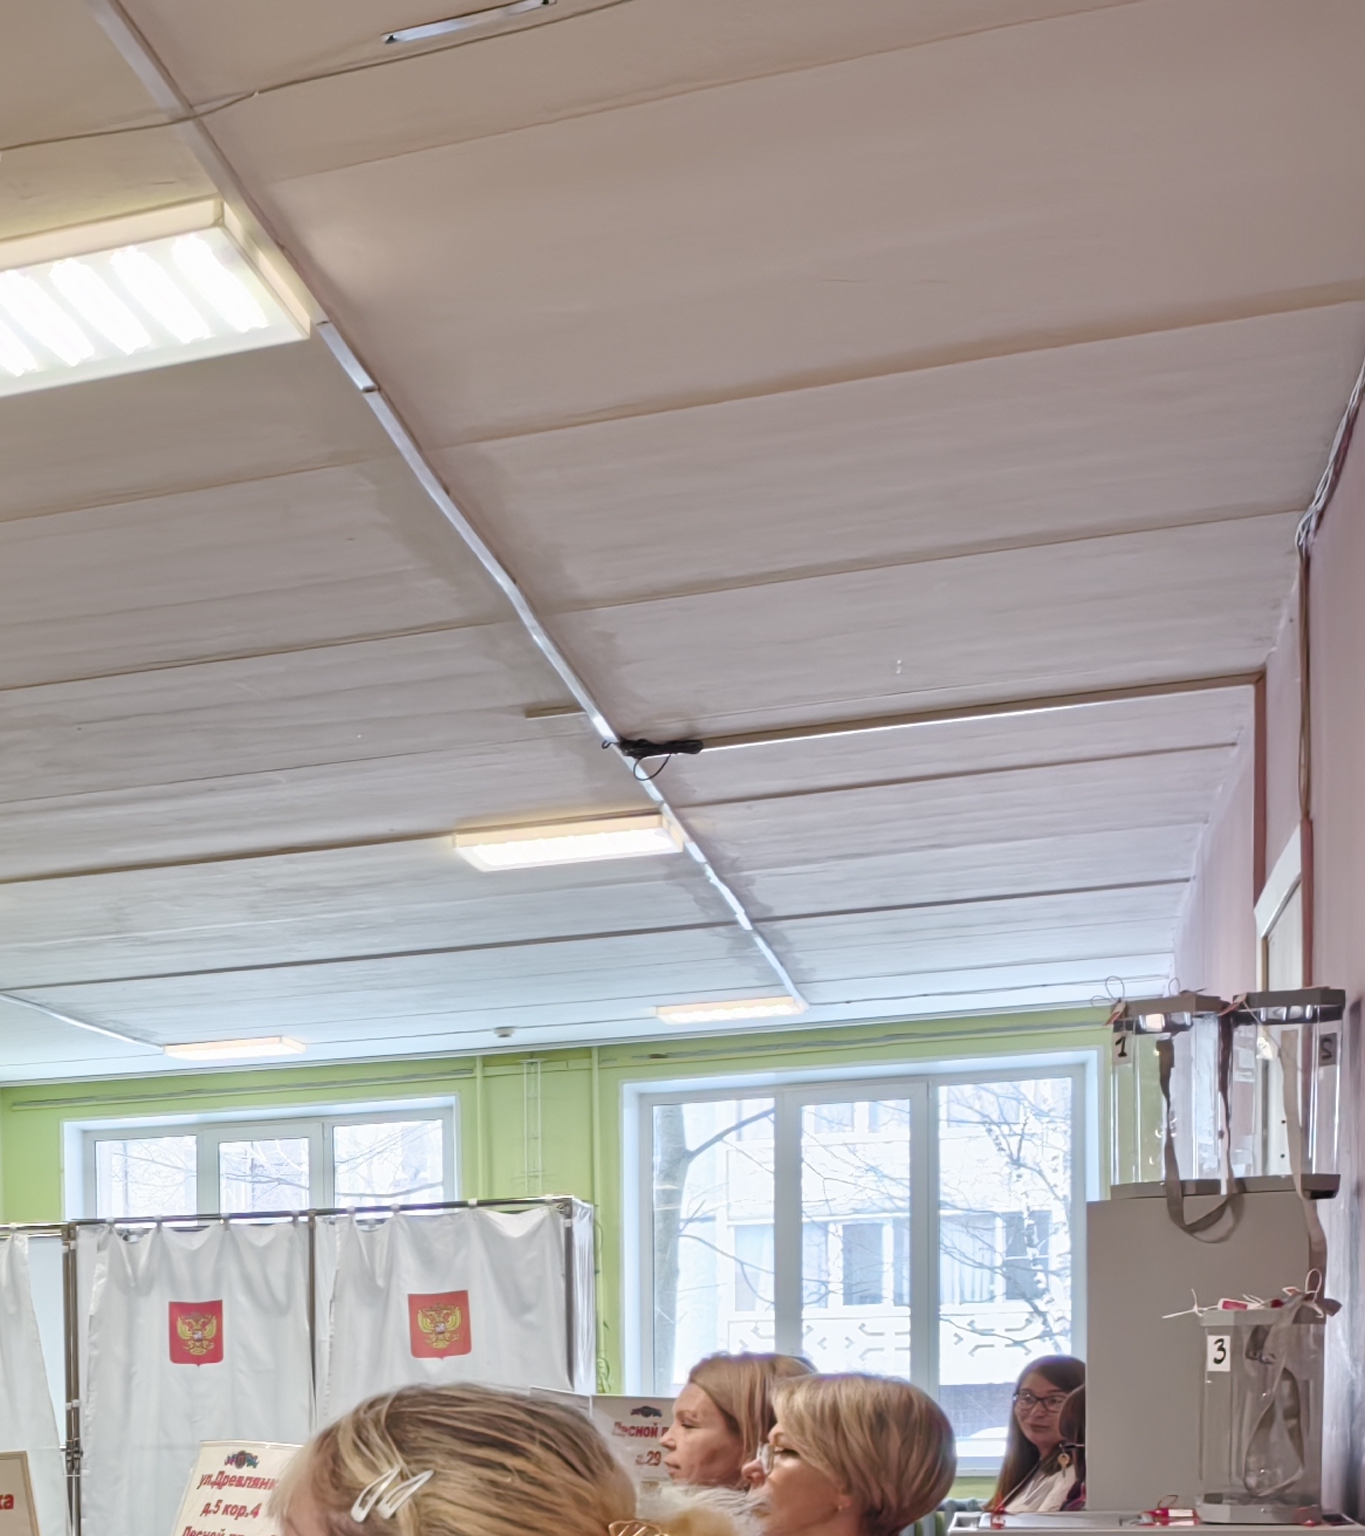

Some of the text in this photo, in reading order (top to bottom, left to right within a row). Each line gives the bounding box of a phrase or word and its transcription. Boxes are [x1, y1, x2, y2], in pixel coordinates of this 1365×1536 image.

[1213, 1338, 1227, 1365] 3
[196, 1470, 278, 1490] ул.Древлянк
[199, 1499, 263, 1520] д.5 кор.4
